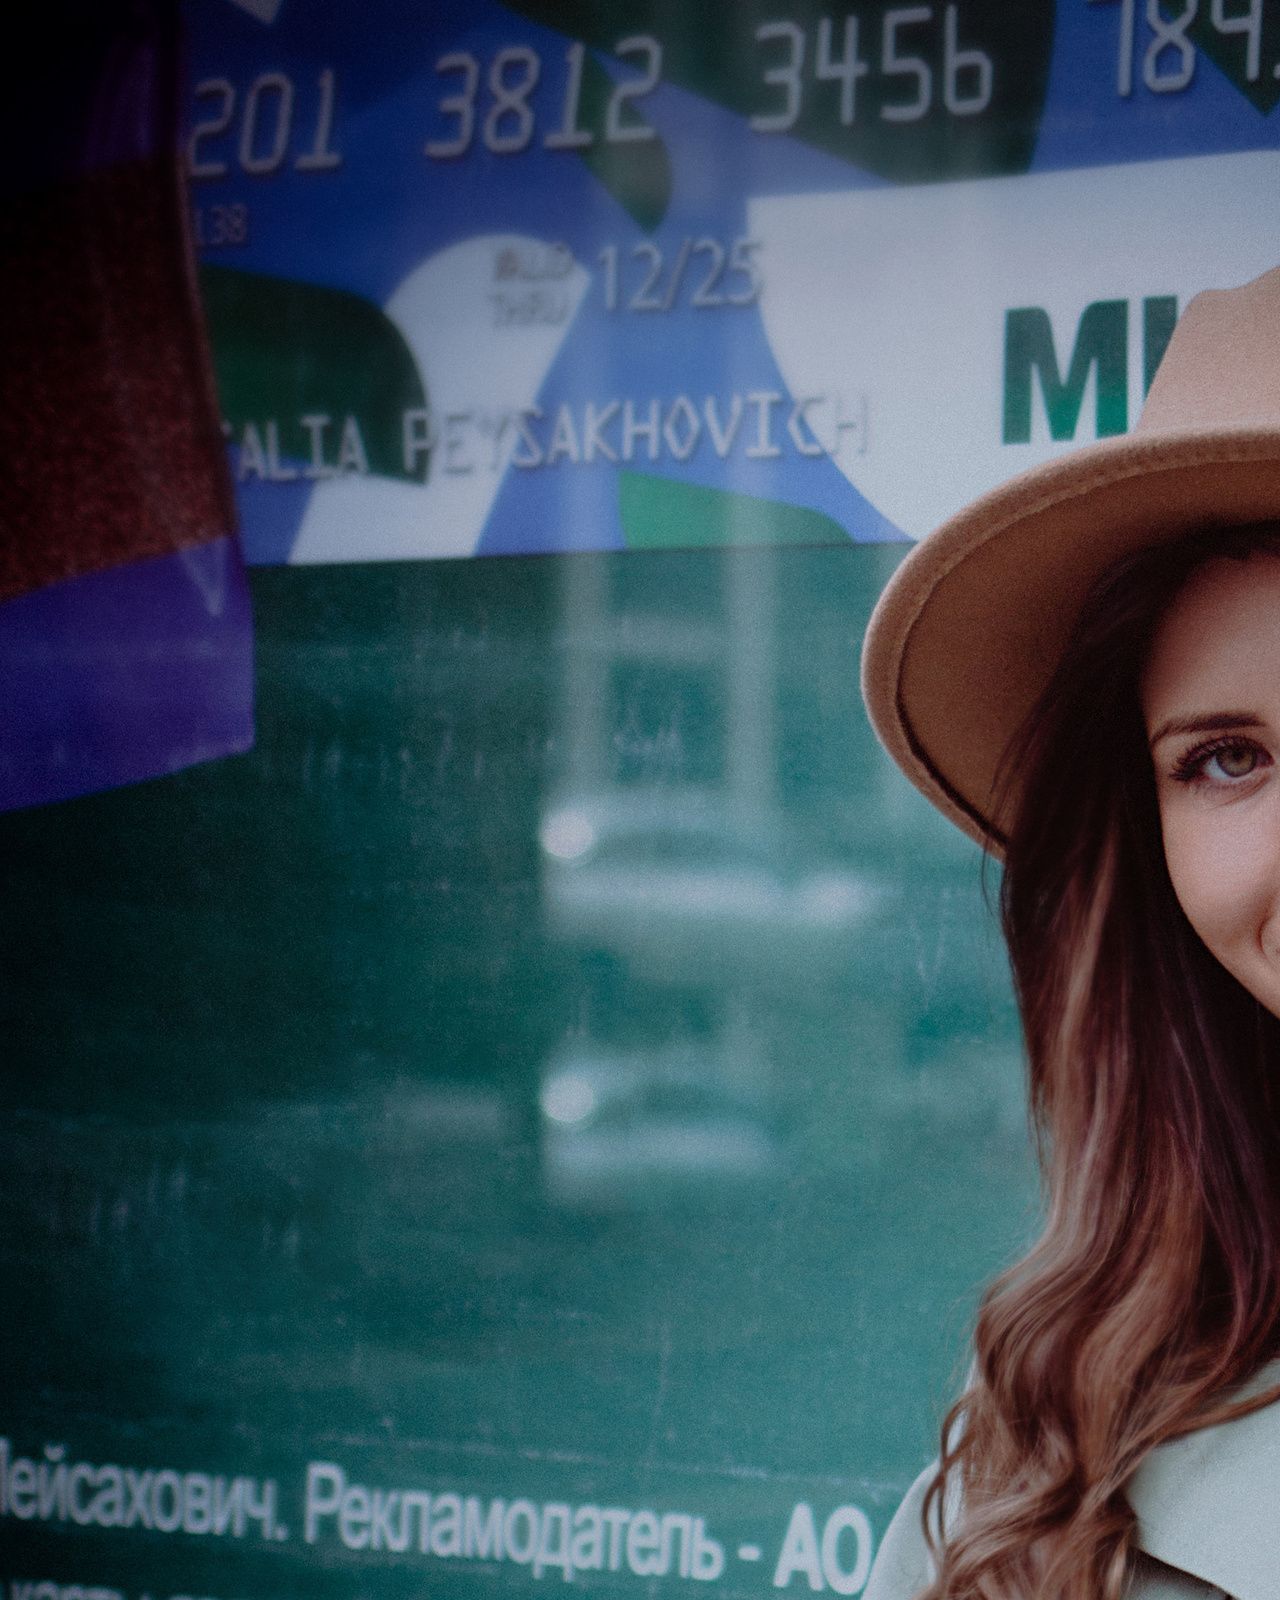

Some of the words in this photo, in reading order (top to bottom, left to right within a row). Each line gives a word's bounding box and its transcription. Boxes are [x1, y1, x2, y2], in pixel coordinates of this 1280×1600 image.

[188, 70, 343, 178] 201
[425, 34, 664, 160] 3812
[750, 4, 994, 132] 3456
[598, 238, 764, 314] 12/25
[402, 390, 872, 475] PEYSAKHOVICH
[304, 1461, 726, 1582] Рекламодатель
[773, 1502, 874, 1597] АО
